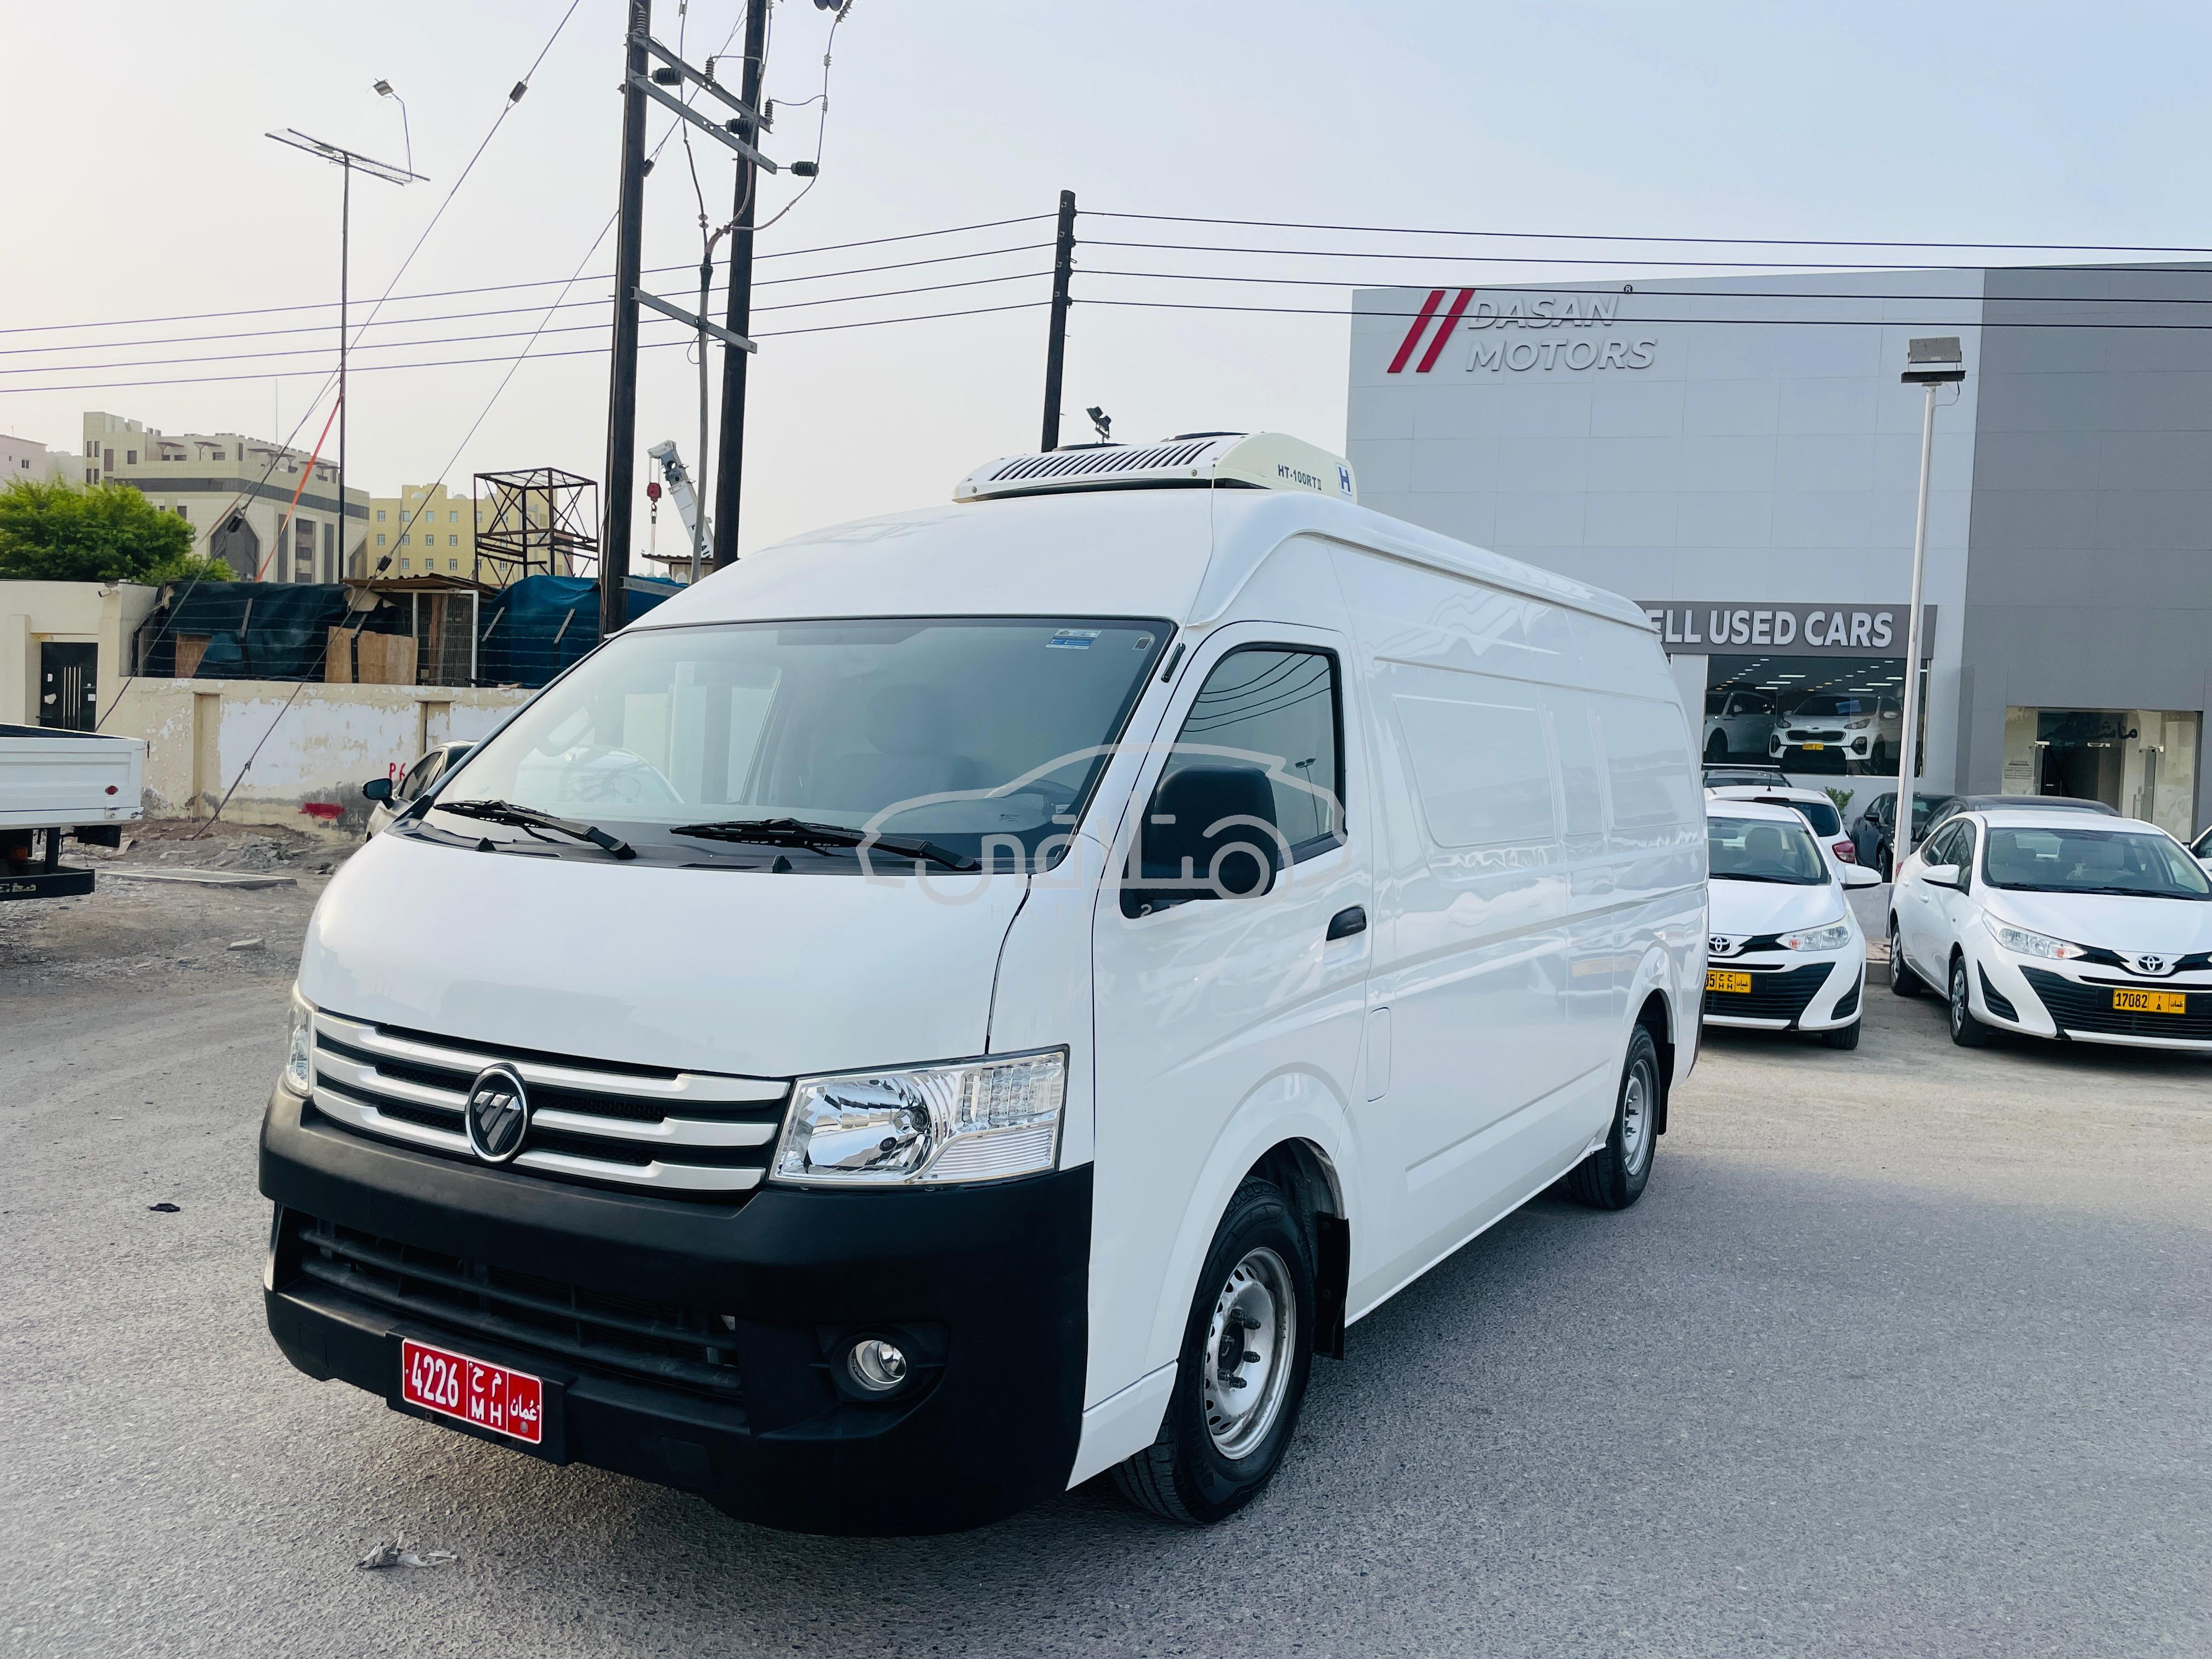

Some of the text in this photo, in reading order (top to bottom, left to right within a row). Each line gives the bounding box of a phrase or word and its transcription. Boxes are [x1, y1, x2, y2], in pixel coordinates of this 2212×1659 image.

[1468, 295, 1619, 329] DASAN
[1466, 337, 1657, 371] MOTORS
[1709, 610, 1797, 645] USED
[1804, 612, 1894, 647] CARS
[2115, 992, 2148, 1008] 17082
[412, 1351, 459, 1408] 4226
